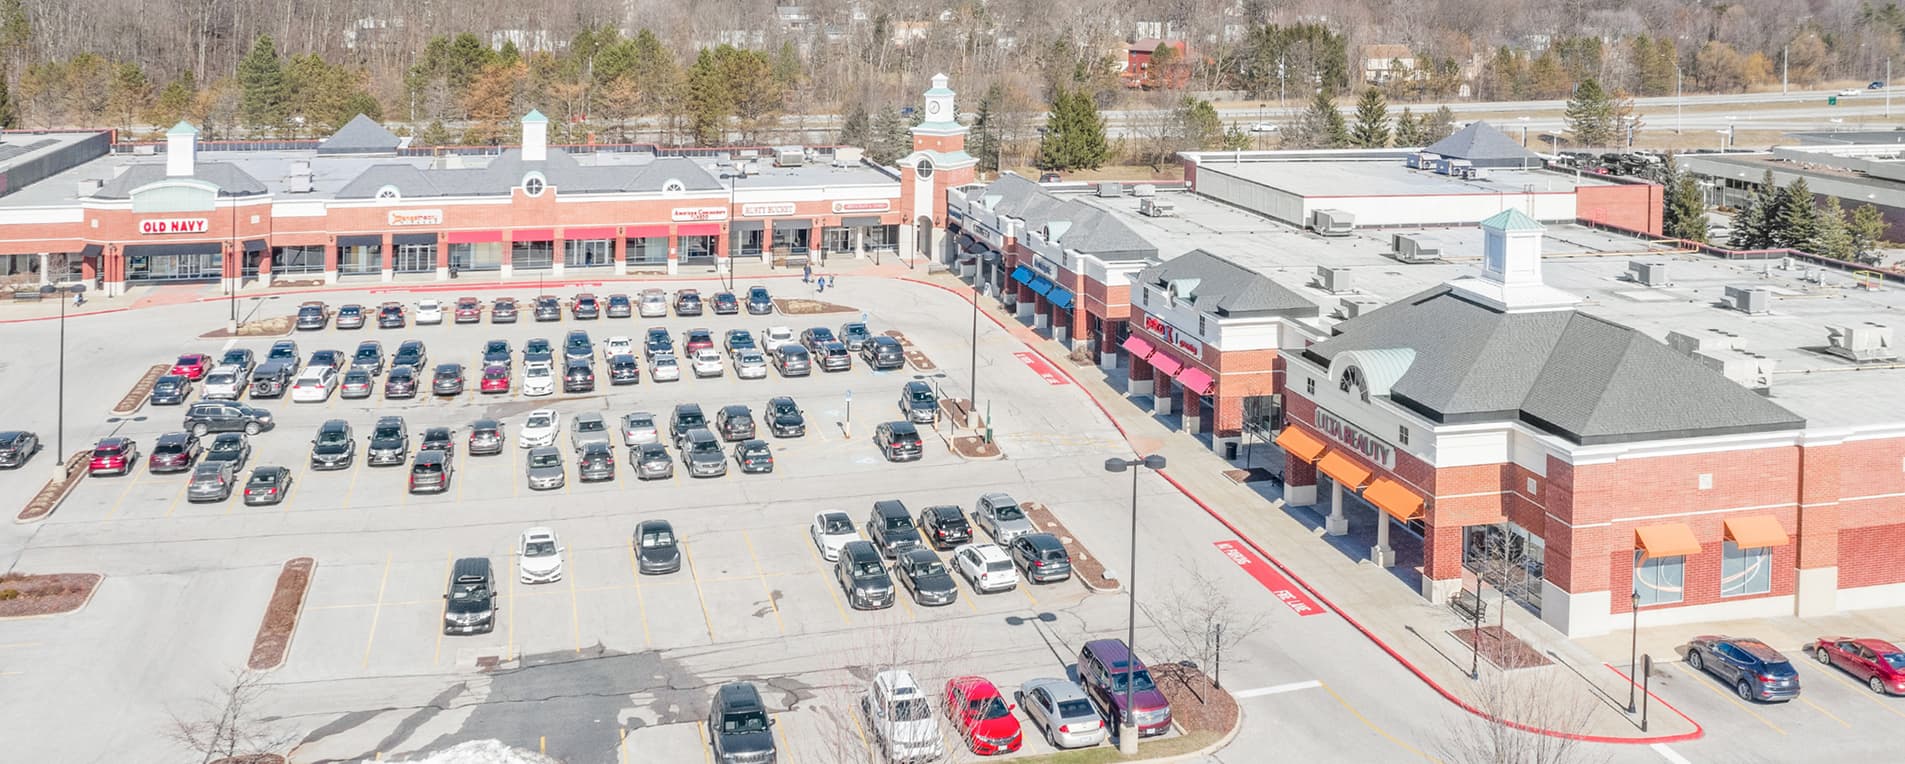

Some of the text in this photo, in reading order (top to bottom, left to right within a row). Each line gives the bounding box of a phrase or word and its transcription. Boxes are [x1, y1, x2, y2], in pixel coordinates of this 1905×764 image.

[143, 220, 204, 233] OLD NAVY
[1316, 410, 1390, 466] ULTA BEAUTY
